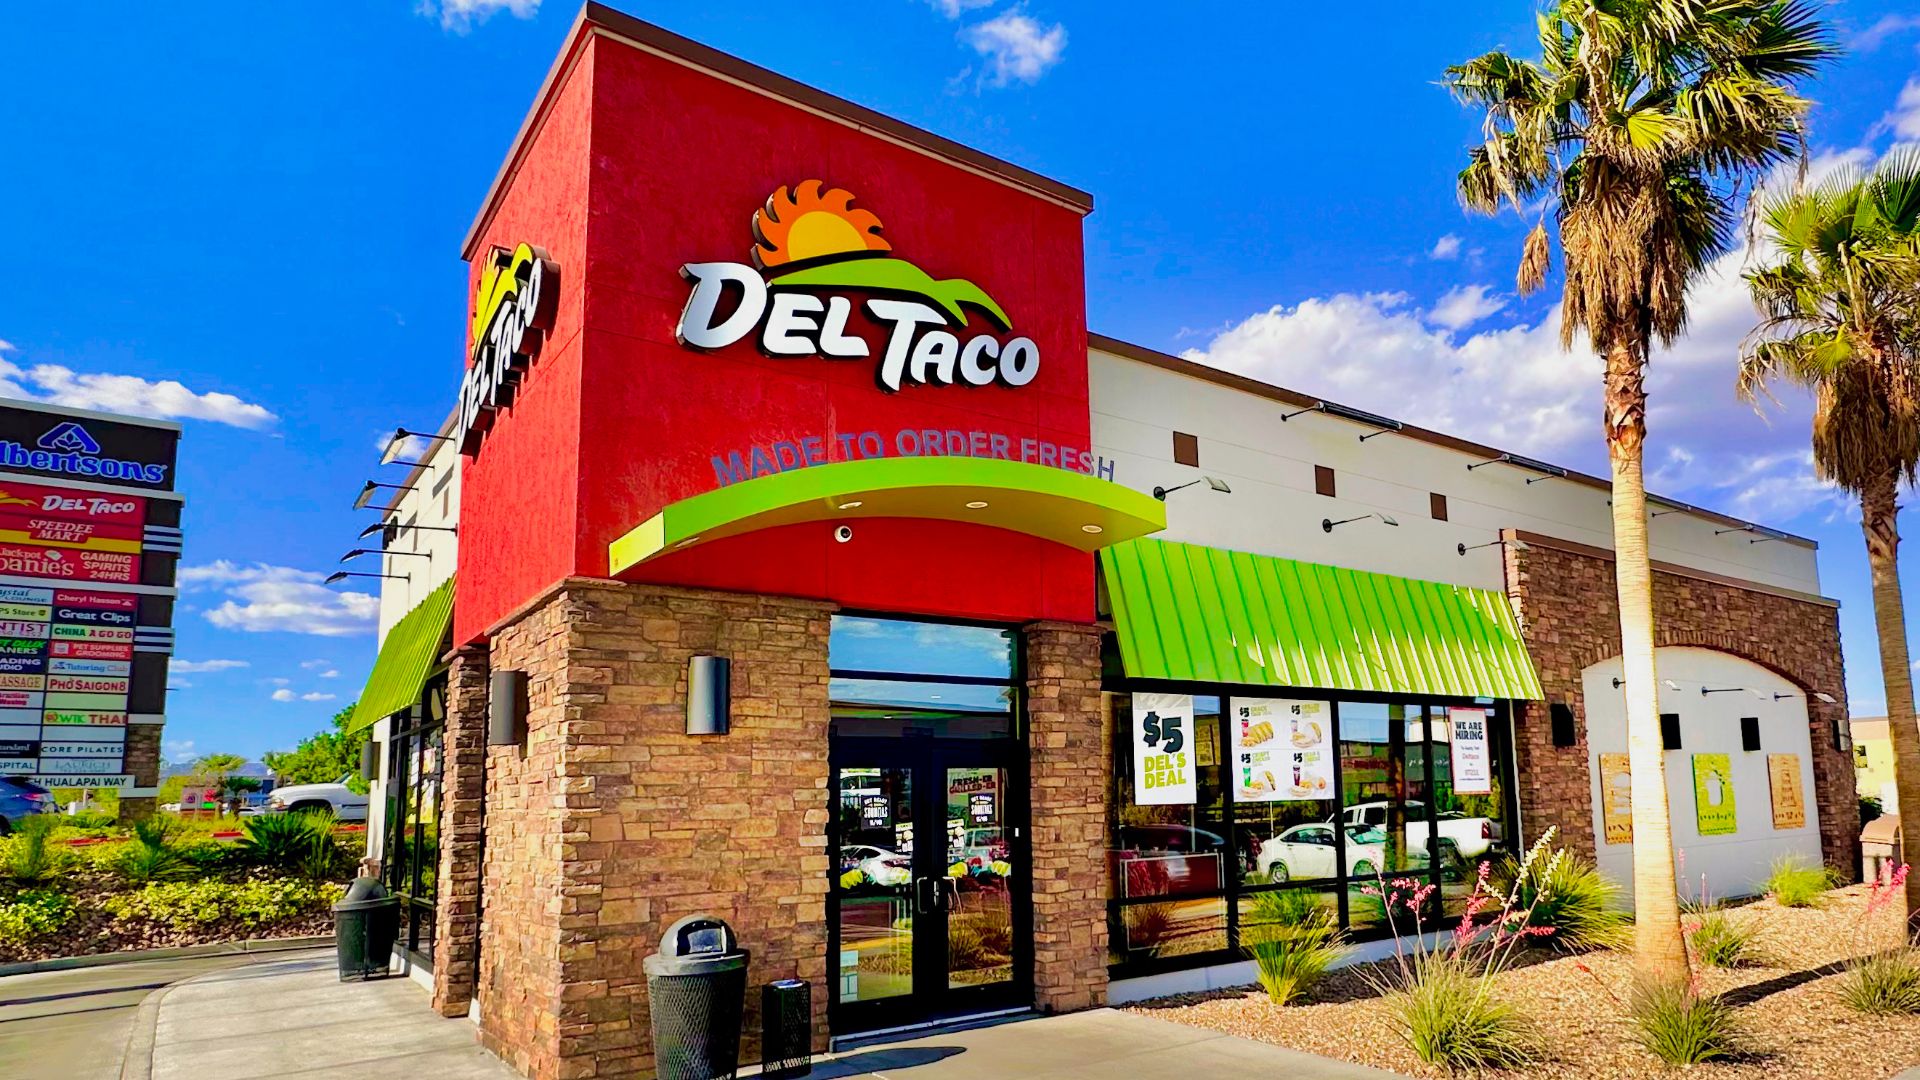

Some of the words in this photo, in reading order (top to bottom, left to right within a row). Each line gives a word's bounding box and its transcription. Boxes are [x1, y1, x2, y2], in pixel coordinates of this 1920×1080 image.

[711, 436, 827, 487] MADE
[838, 431, 885, 462] TO
[895, 429, 1010, 460] ORDER
[1020, 438, 1115, 483] FRESH
[27, 519, 95, 534] SPEEDEE
[37, 529, 85, 542] MART
[80, 551, 132, 564] GAMING
[82, 560, 131, 573] SPIRITS
[90, 570, 131, 581] 24HRS
[57, 593, 87, 604] Cheryl
[12, 608, 36, 617] Store
[58, 608, 97, 621] Great
[100, 611, 131, 624] Clips
[54, 627, 86, 637] CHINA
[89, 629, 96, 637] A
[98, 630, 114, 638] GO
[116, 630, 132, 639] GO
[90, 644, 128, 652] SUPPLIES
[76, 650, 126, 658] GROOMING
[66, 662, 105, 672] Tutoring
[0, 675, 41, 688] ASSAGE
[1240, 706, 1250, 718] $5
[1291, 704, 1301, 715] $5
[1455, 721, 1467, 730] WE
[1468, 721, 1483, 730] ARE
[1143, 711, 1184, 754] $5
[1455, 730, 1483, 741] HIRING
[1144, 752, 1187, 773] DEL'S
[1241, 753, 1251, 764] $5
[1293, 752, 1303, 763] $5
[45, 777, 101, 787] HUALAPAI
[104, 777, 127, 786] WAY
[1144, 769, 1187, 790] DEAL
